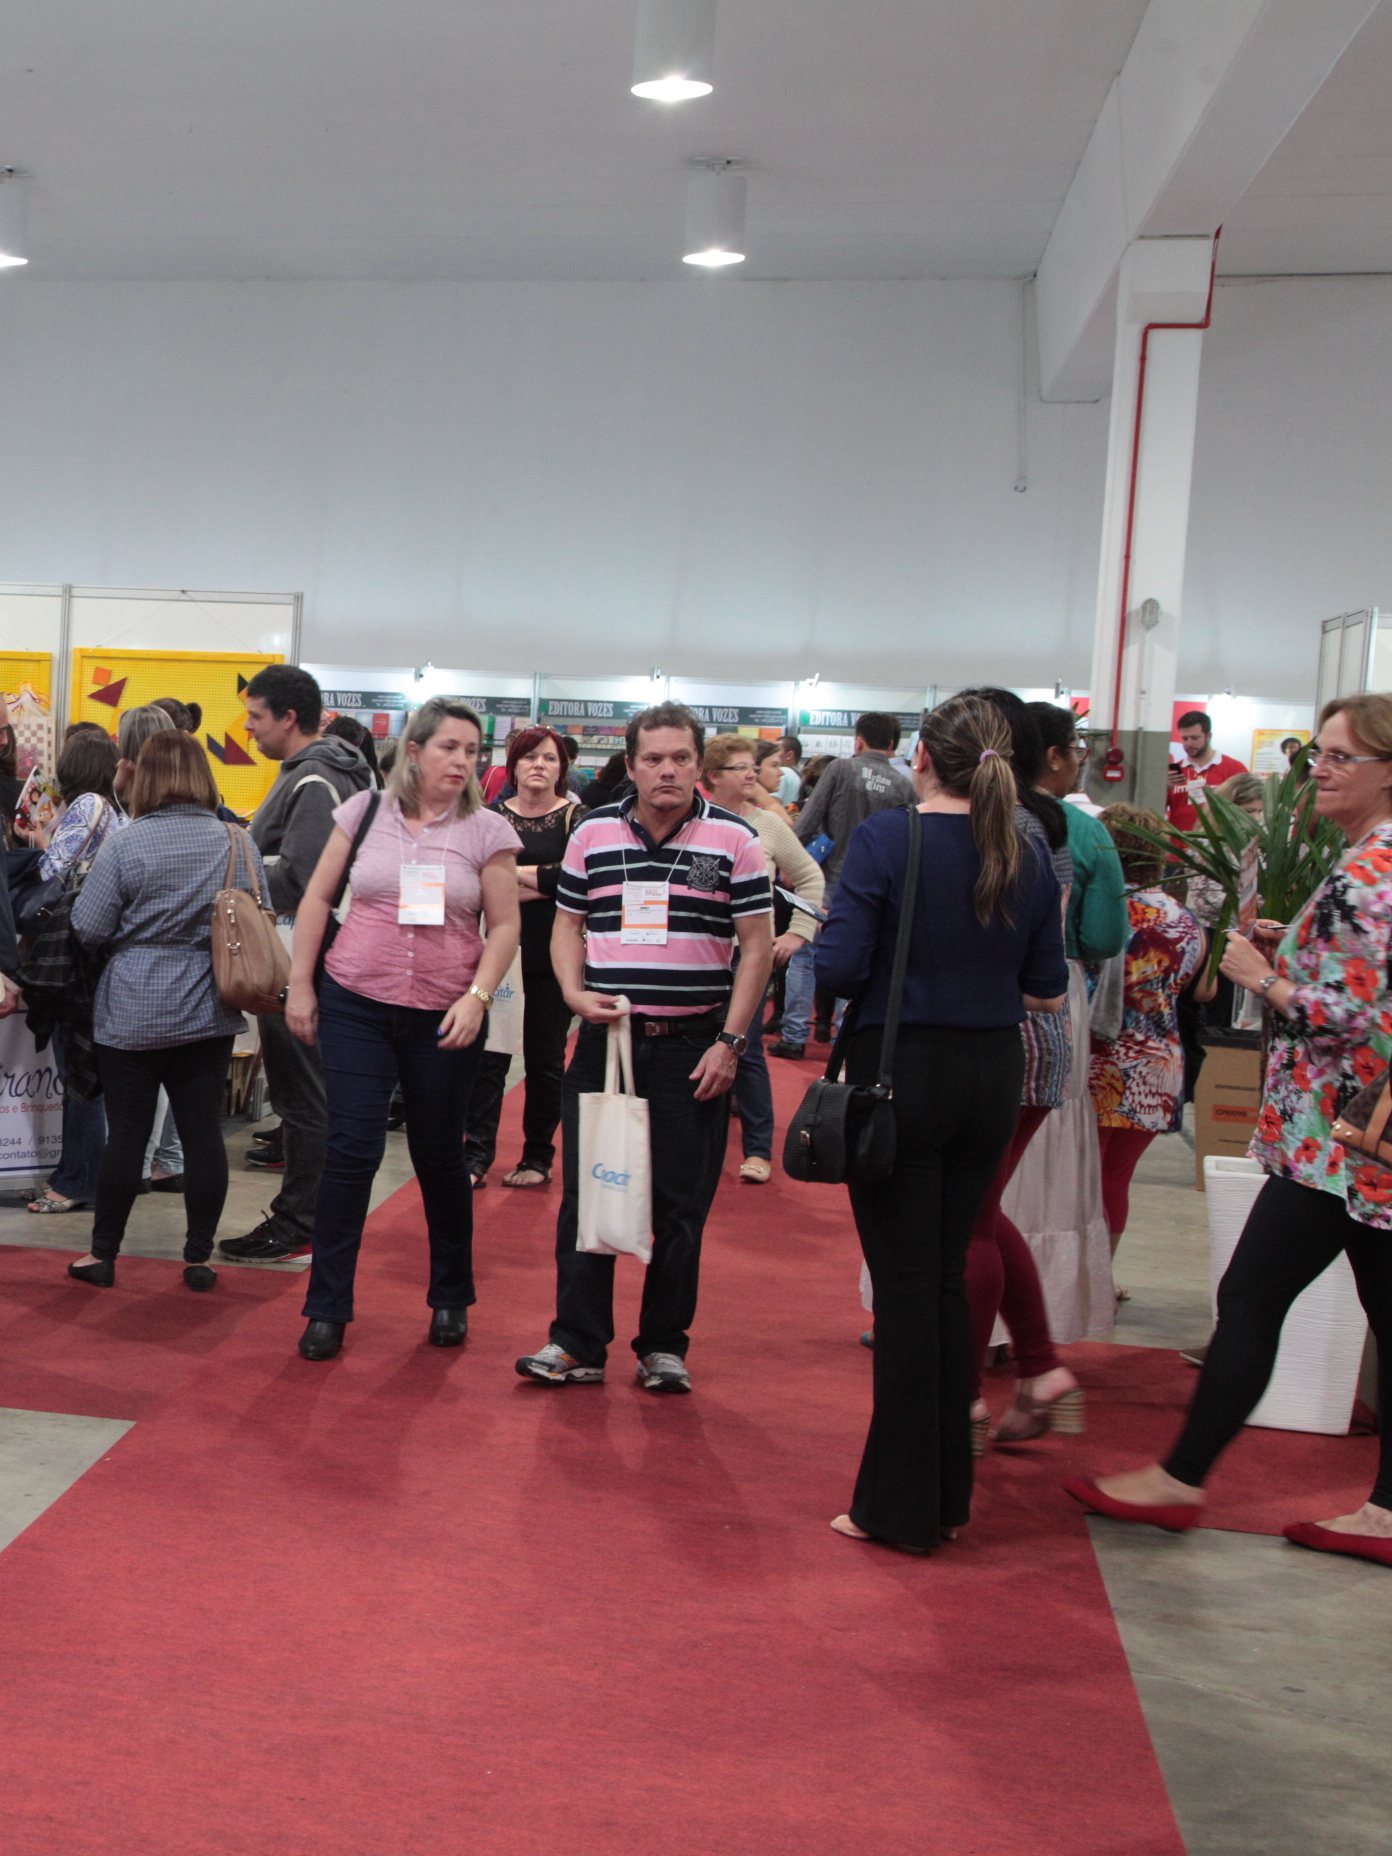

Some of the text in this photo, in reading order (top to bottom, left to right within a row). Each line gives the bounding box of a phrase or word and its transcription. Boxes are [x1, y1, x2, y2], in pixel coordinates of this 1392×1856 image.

[548, 701, 585, 716] EDITORA
[587, 702, 614, 717] VOZES
[712, 707, 740, 722] VOZES
[810, 711, 848, 726] EDITORA
[12, 1105, 18, 1113] e
